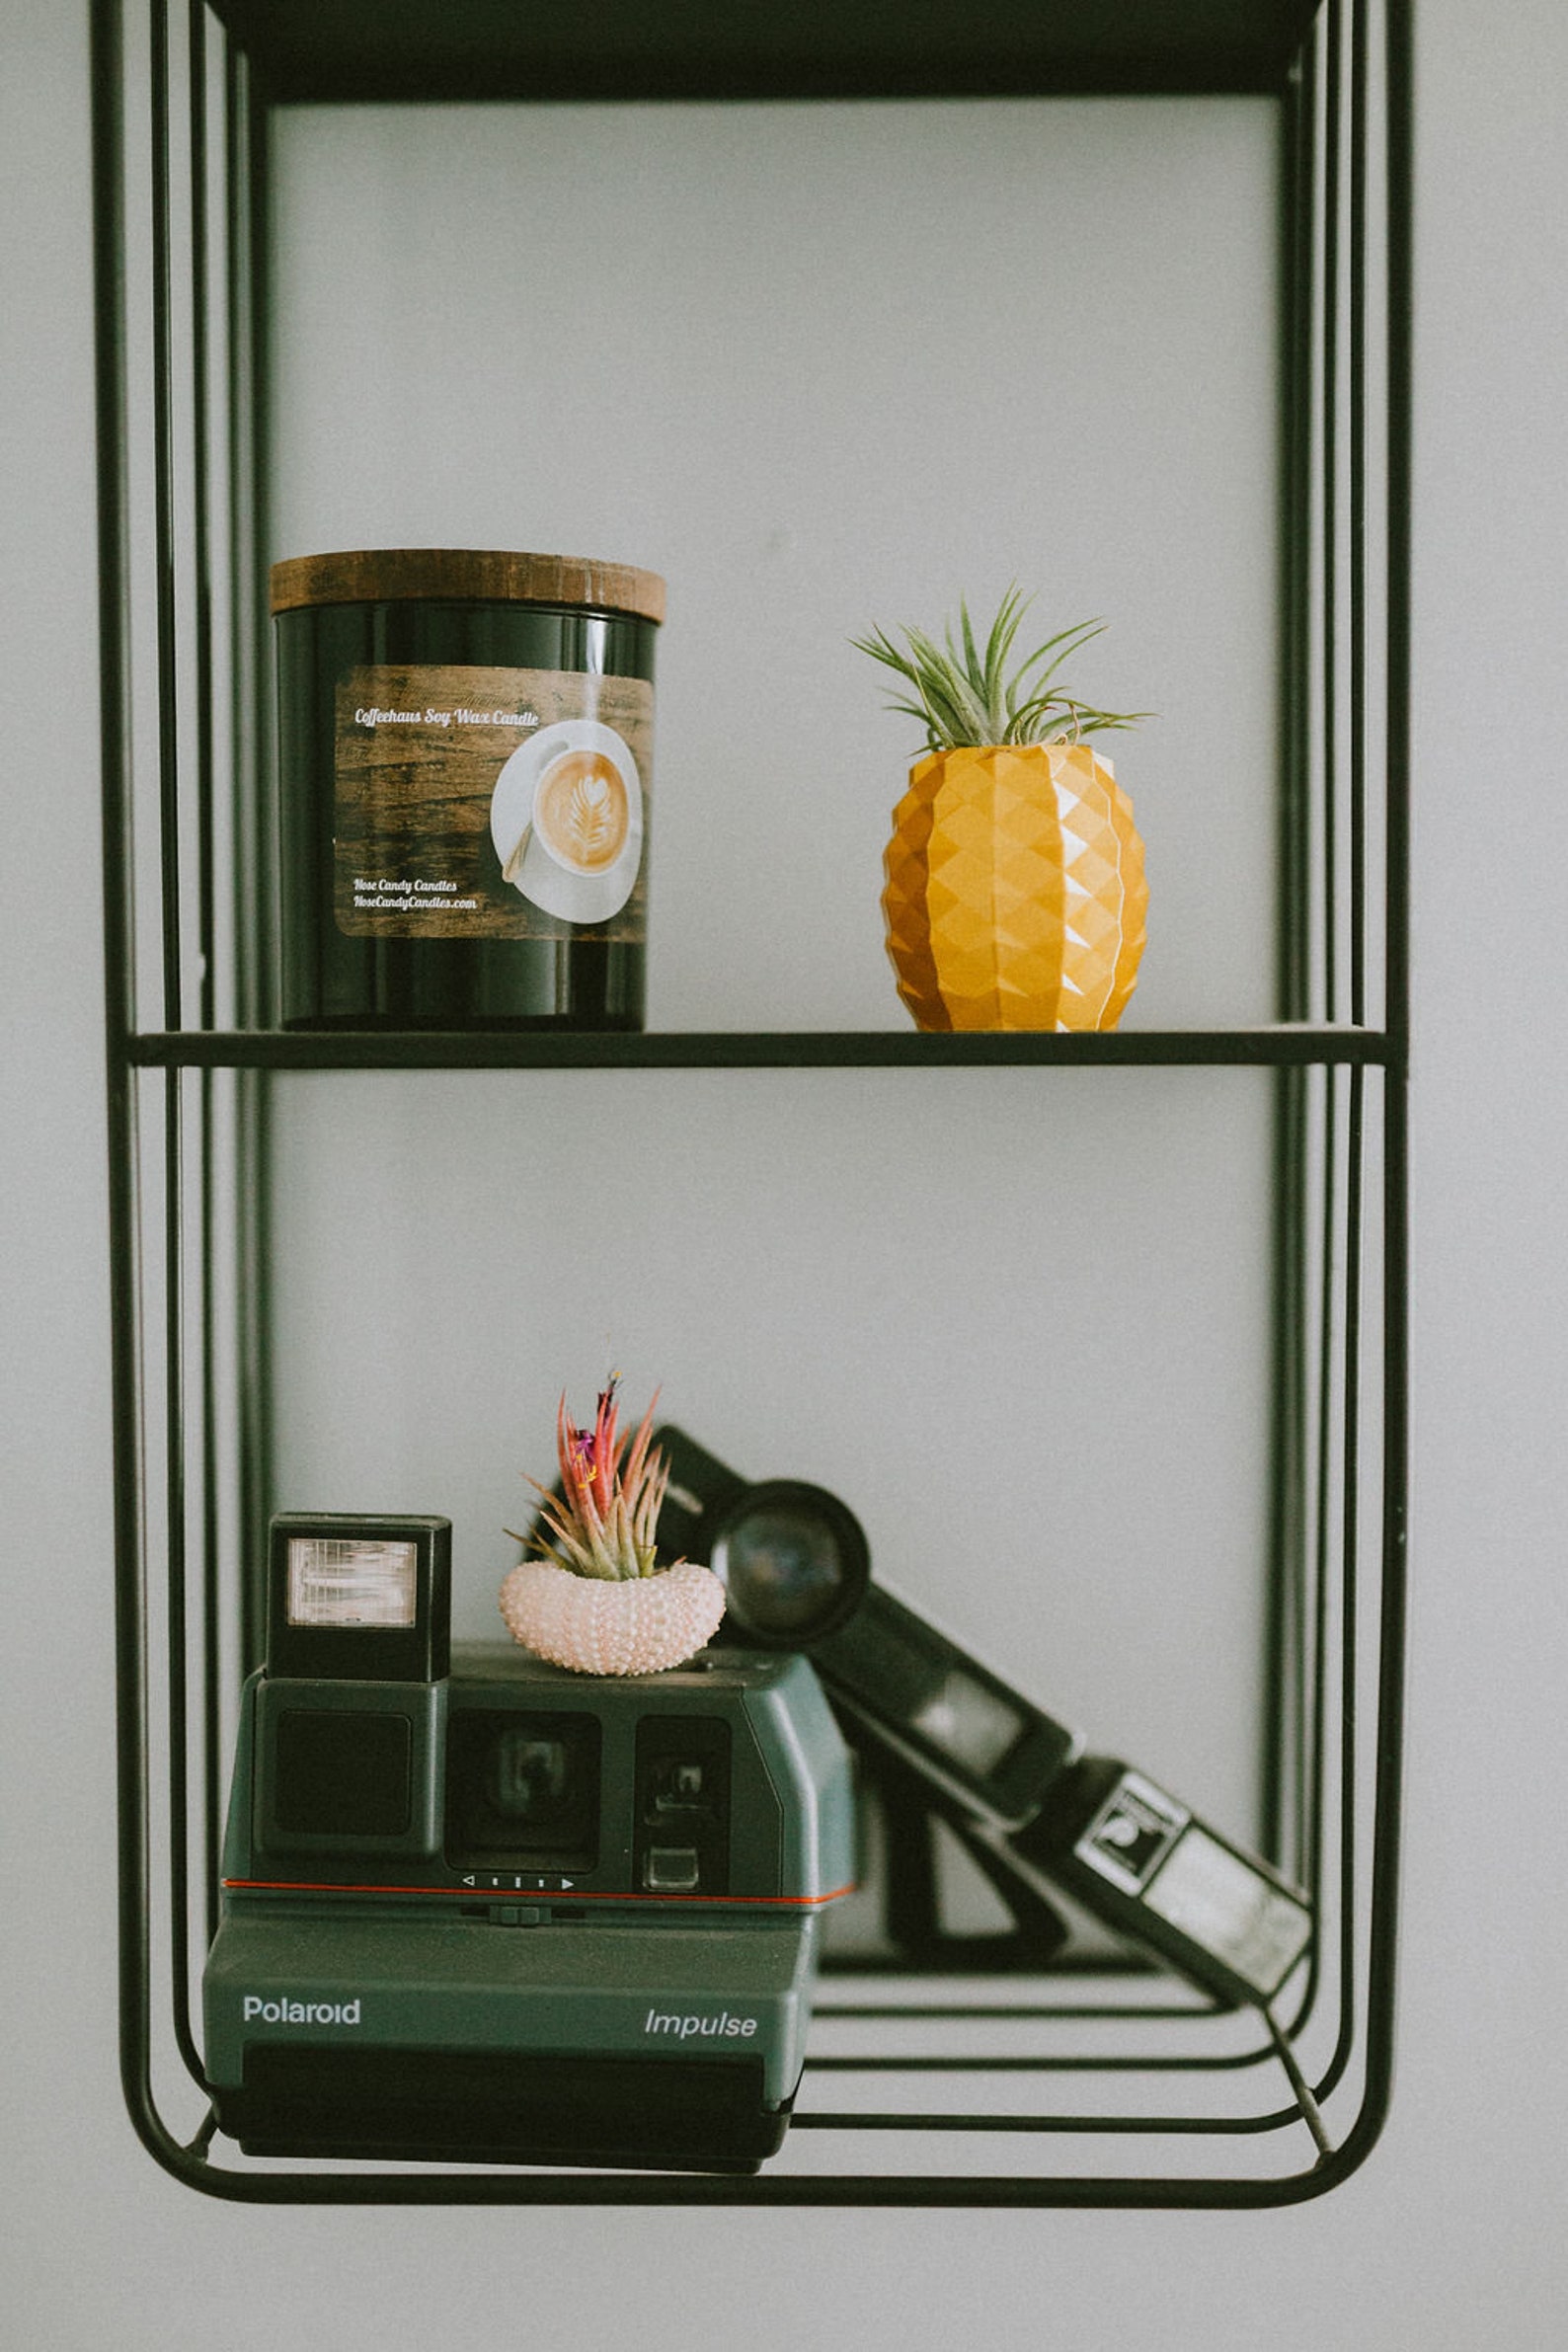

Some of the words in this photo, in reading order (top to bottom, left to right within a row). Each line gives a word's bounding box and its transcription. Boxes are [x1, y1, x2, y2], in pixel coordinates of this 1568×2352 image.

[354, 708, 422, 727] Coffeehaus
[424, 708, 450, 727] Soy
[454, 708, 491, 724] Wax
[493, 710, 539, 726] Candle
[353, 878, 377, 891] Nose
[378, 879, 412, 894] Candy
[414, 879, 457, 892] Candles
[353, 896, 477, 910] NoseCandyCandles.com
[243, 1996, 361, 2024] Polaroid
[644, 2008, 757, 2040] Impulse
